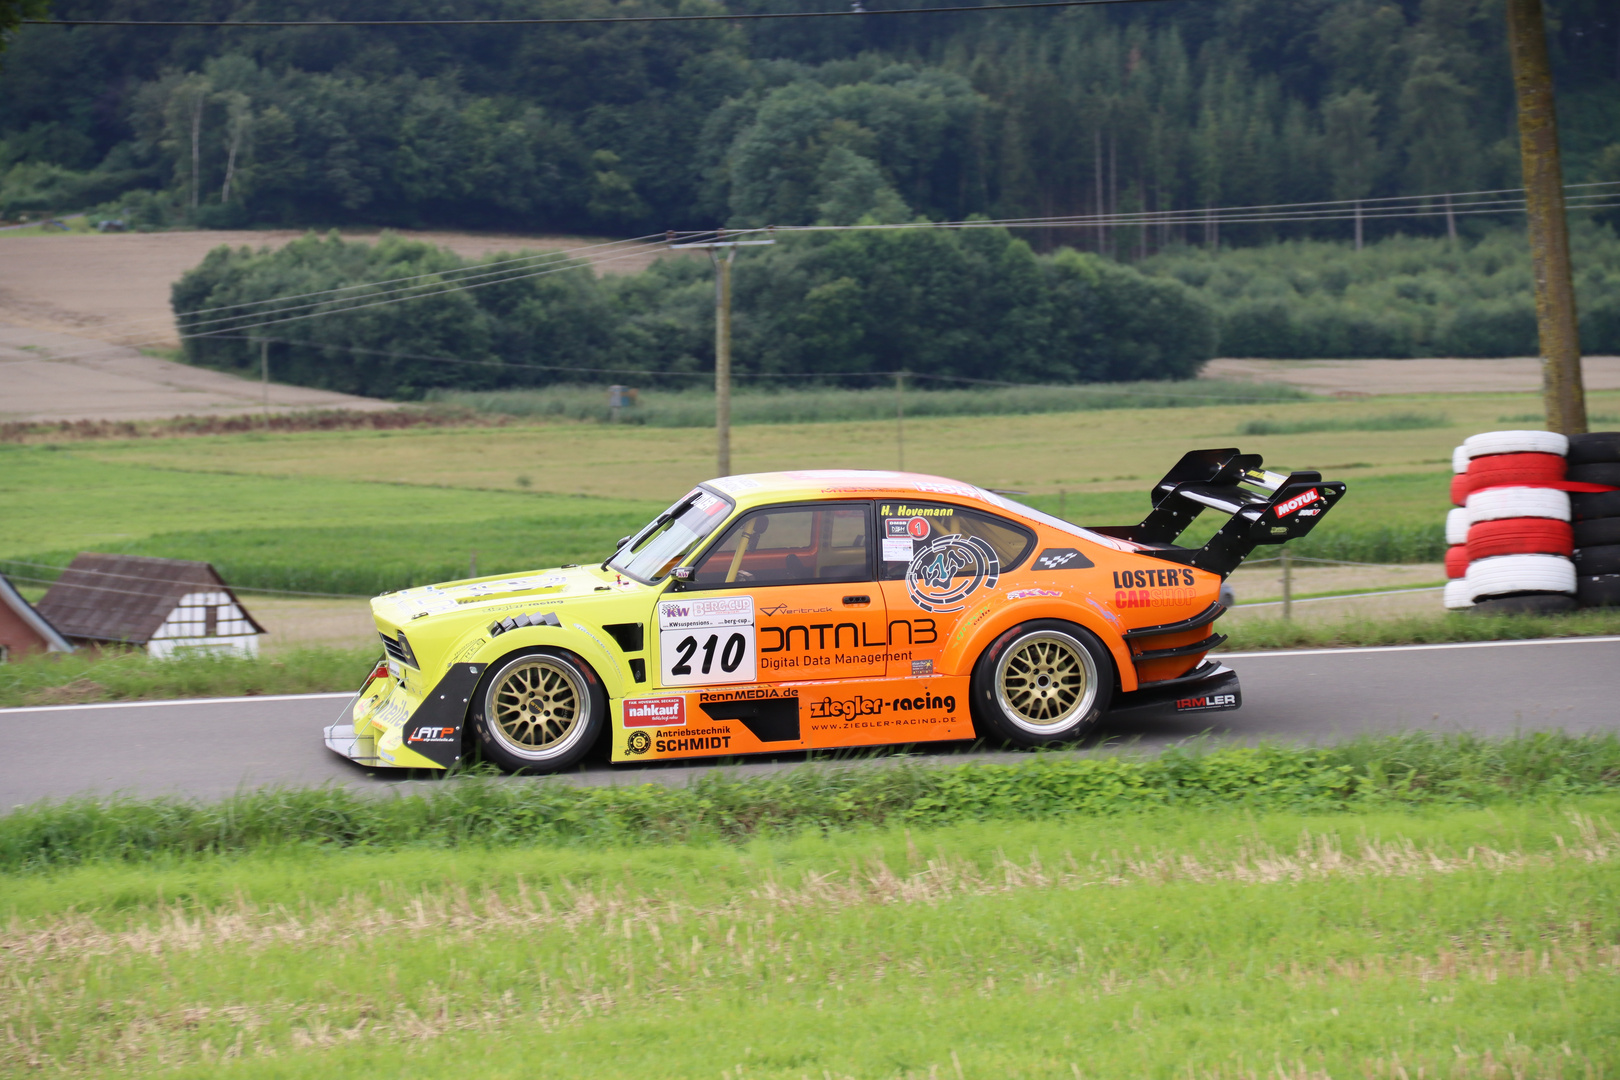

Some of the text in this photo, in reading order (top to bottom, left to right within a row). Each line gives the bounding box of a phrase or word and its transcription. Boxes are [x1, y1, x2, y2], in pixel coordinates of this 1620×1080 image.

[1277, 490, 1318, 516] MOTUL
[881, 505, 954, 516] H. Hovemann
[915, 522, 921, 535] 1
[1113, 568, 1195, 589] LOSTER'S
[667, 600, 751, 618] KW BERG-CUP
[780, 606, 833, 615] Veritruck
[671, 632, 746, 676] 210
[761, 651, 913, 670] Digital Data Management
[699, 688, 799, 702] RennMEDIA.de
[1176, 694, 1236, 708] IRMLER
[629, 703, 679, 717] nahkauf
[810, 692, 956, 721] ziegler-racing
[811, 717, 957, 730] WWW.ZIEGLER-RACING.DE
[411, 727, 455, 739] ATP
[656, 726, 731, 738] Antriebstechnik
[656, 736, 731, 752] SCHMIDT
